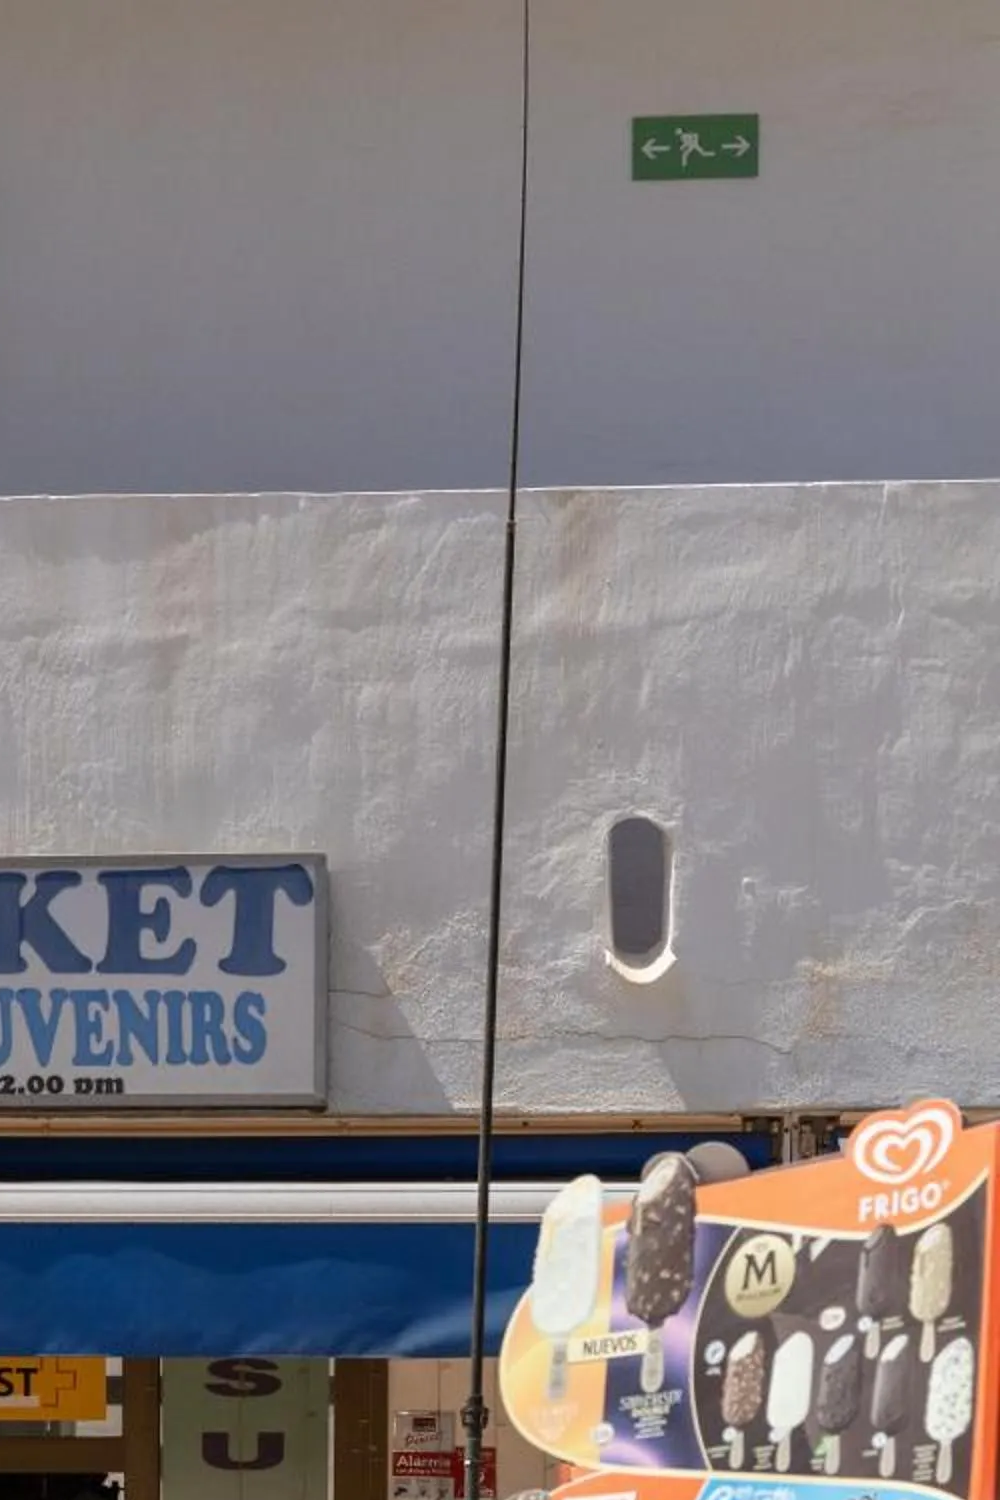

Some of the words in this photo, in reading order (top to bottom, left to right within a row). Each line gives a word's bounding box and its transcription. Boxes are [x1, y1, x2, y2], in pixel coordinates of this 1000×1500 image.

[73, 1076, 126, 1096] pm
[857, 1183, 944, 1223] FRIGO
[740, 1249, 778, 1291] M
[582, 1334, 638, 1356] NUEVOS
